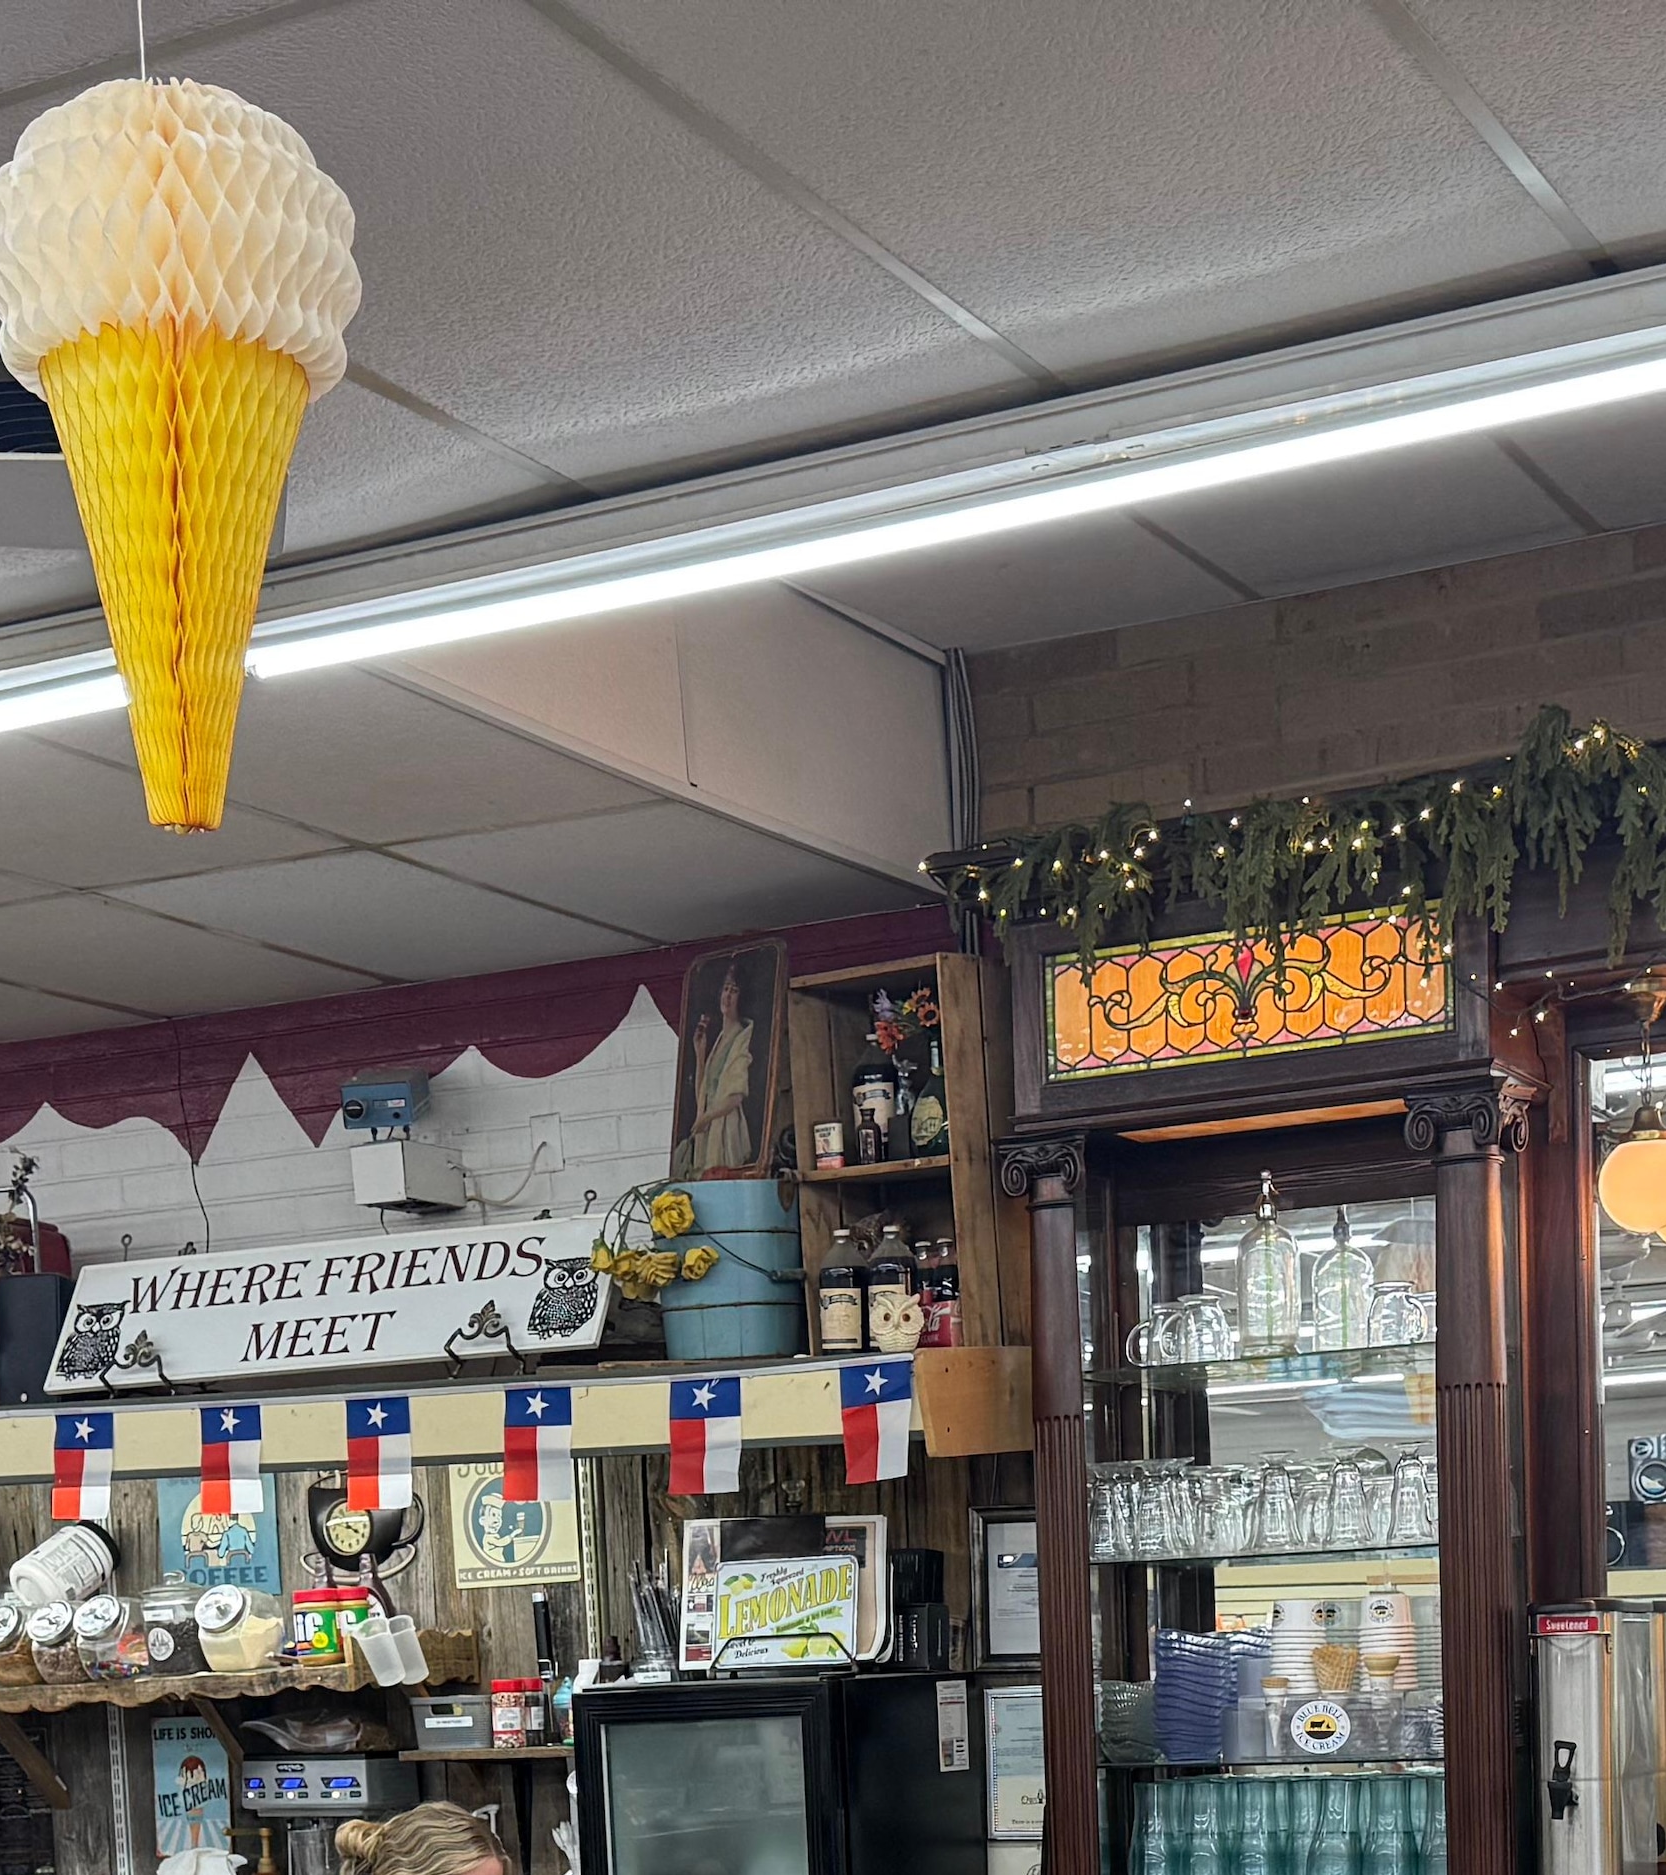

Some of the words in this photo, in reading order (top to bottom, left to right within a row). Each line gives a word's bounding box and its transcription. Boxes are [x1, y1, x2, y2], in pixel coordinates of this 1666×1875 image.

[129, 1259, 309, 1314] WHERE
[315, 1235, 551, 1299] FRIENDS
[239, 1309, 398, 1363] MEET
[476, 1569, 511, 1579] CREAM
[519, 1566, 541, 1577] SOFT
[718, 1563, 853, 1640] LEMONADE
[1297, 1704, 1321, 1723] BLUE
[1321, 1703, 1344, 1723] BELL
[154, 1728, 174, 1741] LIFE
[176, 1727, 187, 1740] IS
[1296, 1732, 1310, 1747] ICE
[1311, 1732, 1346, 1750] CREAM
[158, 1792, 182, 1818] ICE
[183, 1777, 228, 1812] CREAM
